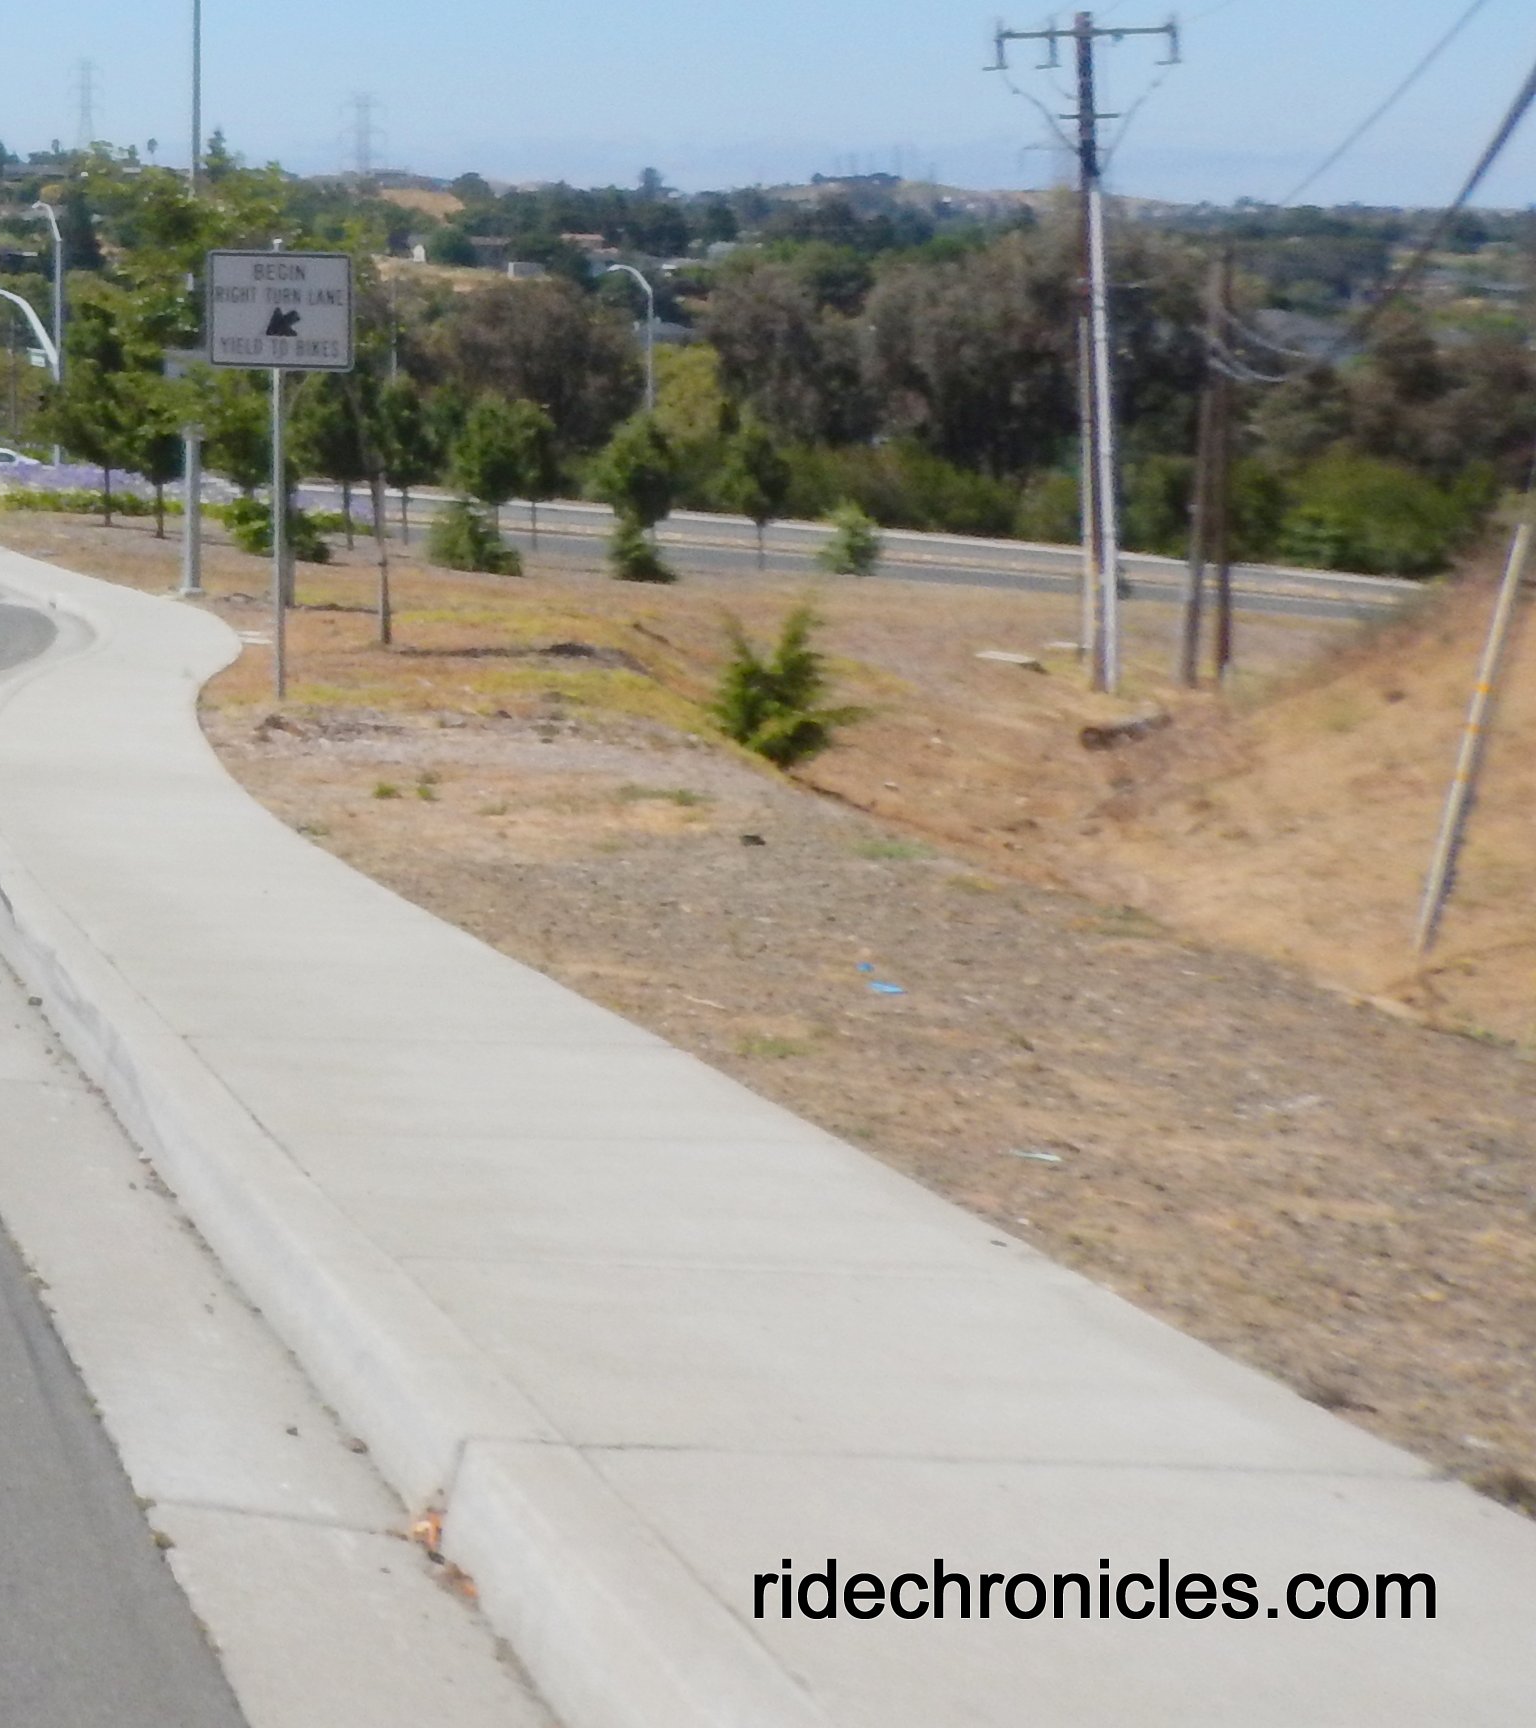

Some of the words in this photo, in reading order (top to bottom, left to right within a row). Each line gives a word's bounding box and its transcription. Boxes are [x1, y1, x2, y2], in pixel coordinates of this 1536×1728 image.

[253, 263, 305, 281] BEGIN
[214, 285, 256, 303] RIGHT
[265, 287, 301, 305] TURN
[309, 289, 343, 306] LANE
[220, 337, 263, 355] YIELD
[270, 338, 289, 358] TO
[295, 340, 339, 358] BIKES
